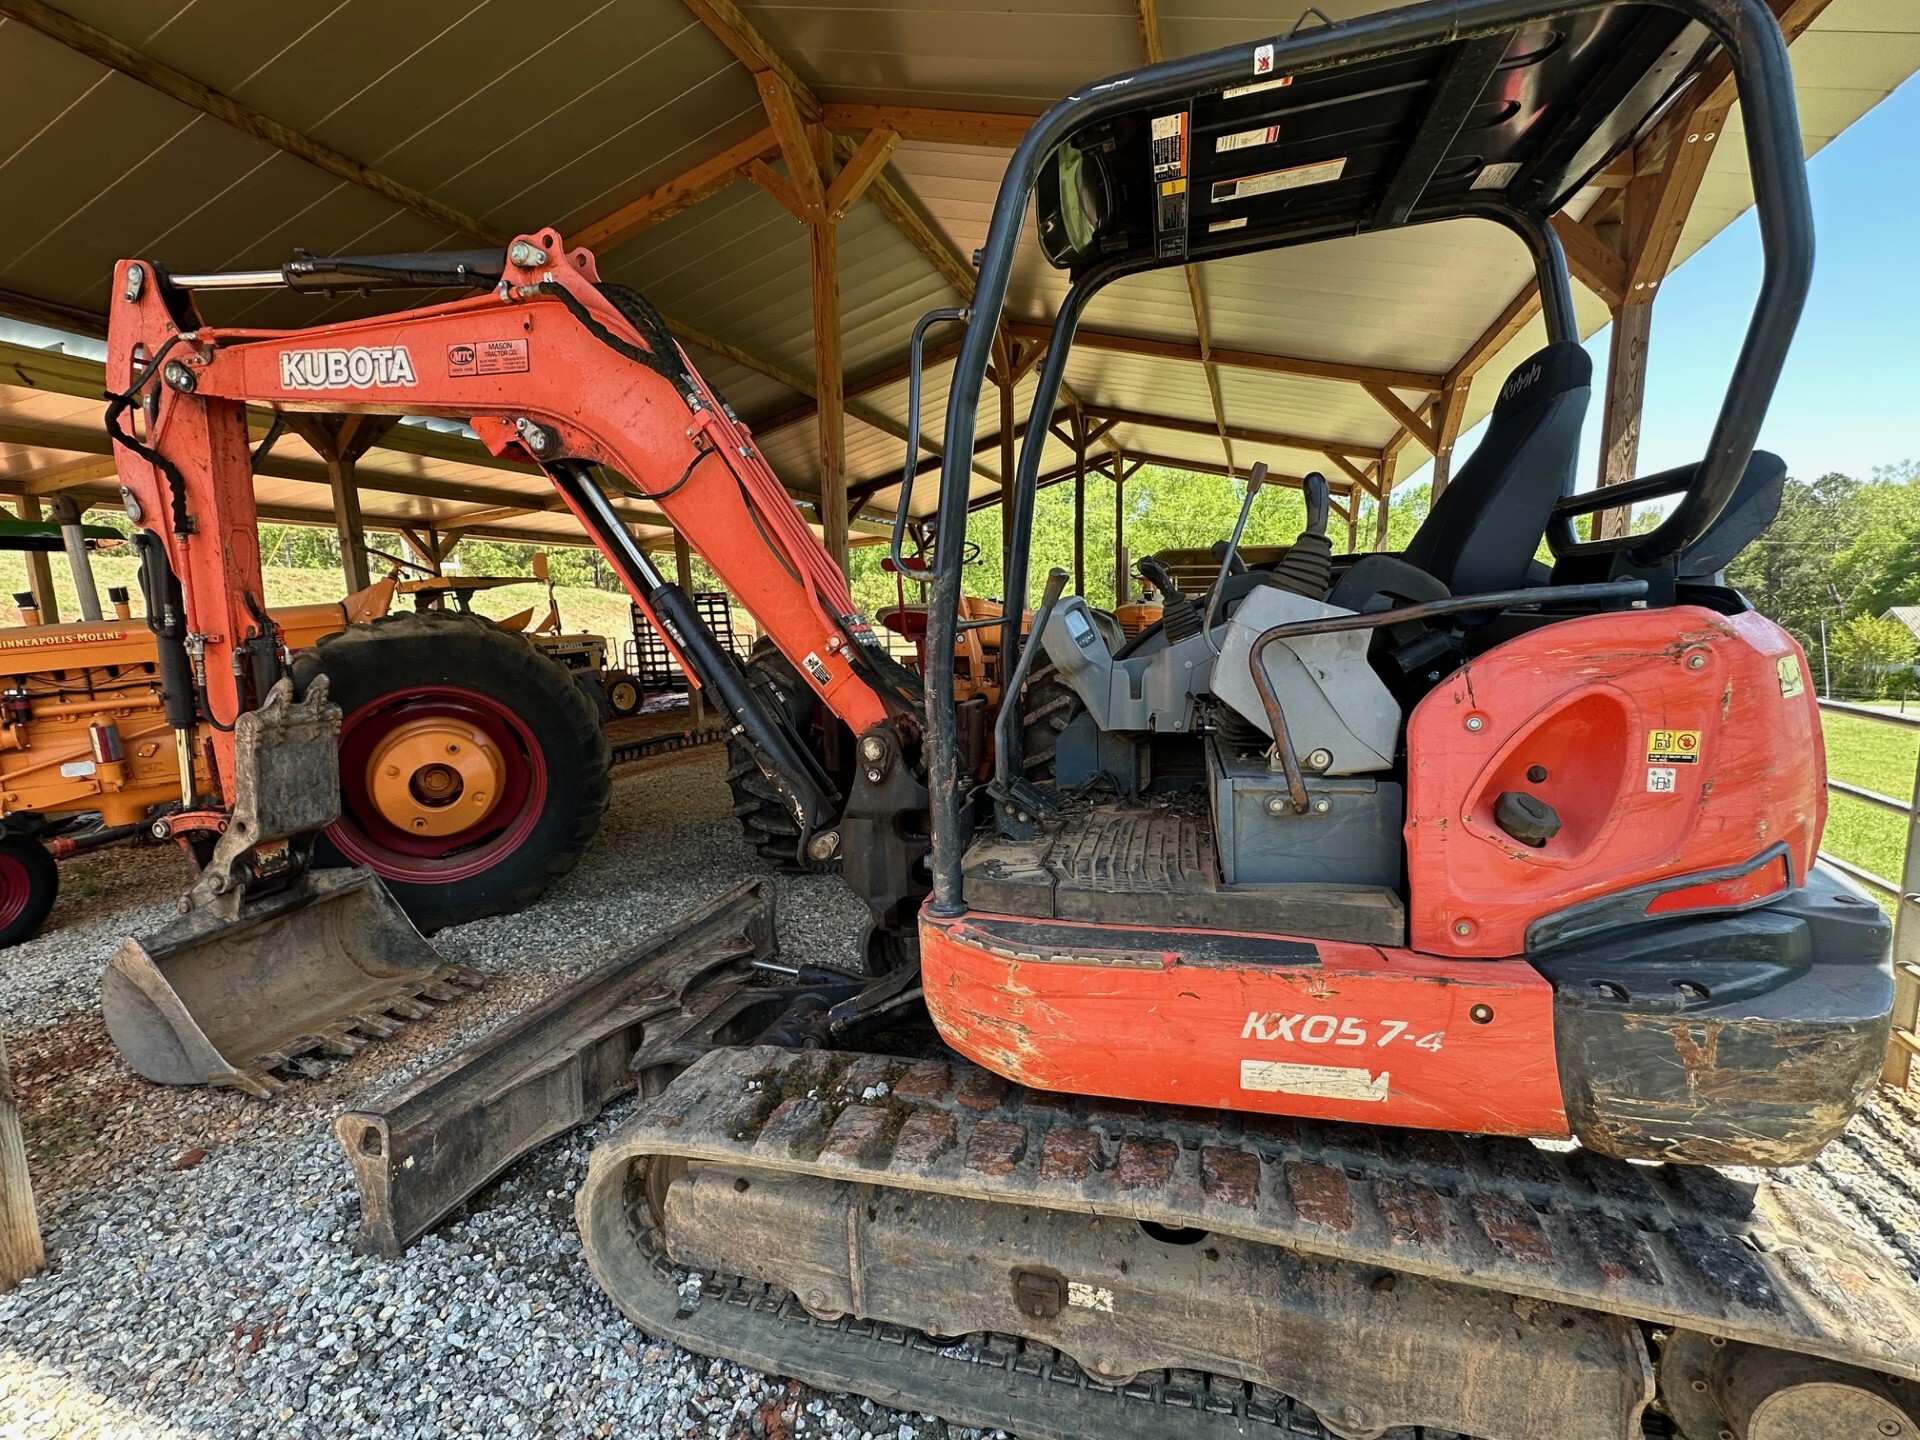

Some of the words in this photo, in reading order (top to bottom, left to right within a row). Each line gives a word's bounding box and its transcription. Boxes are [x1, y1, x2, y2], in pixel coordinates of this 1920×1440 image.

[452, 350, 473, 362] MTC
[488, 342, 512, 350] MASON
[281, 348, 416, 387] KUBOTA
[1502, 363, 1541, 400] Kubota
